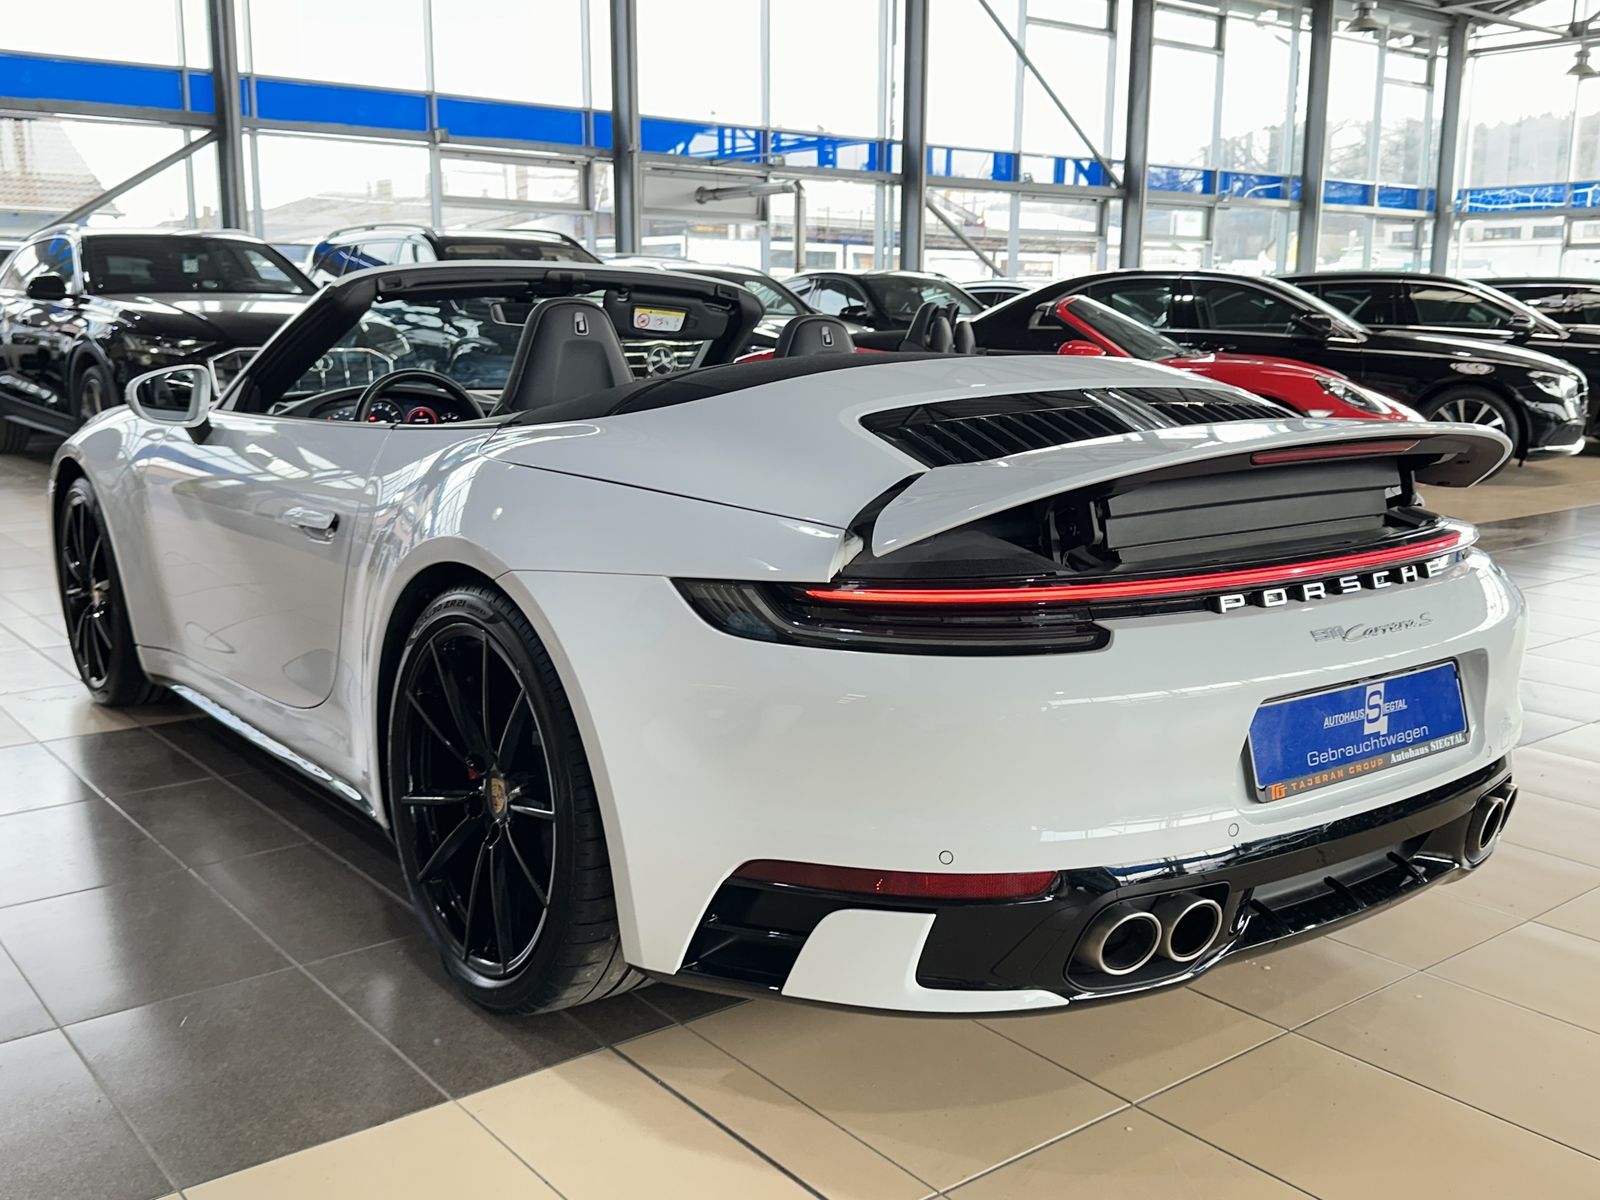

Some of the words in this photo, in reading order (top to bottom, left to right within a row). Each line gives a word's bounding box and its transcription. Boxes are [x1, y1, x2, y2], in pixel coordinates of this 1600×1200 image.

[1219, 557, 1445, 614] PORSCHE
[1341, 622, 1416, 644] Carrera
[1418, 611, 1433, 627] S
[1323, 708, 1366, 729] AUTOHAUS
[1307, 725, 1429, 767] Gebrauchtwagen
[1390, 745, 1430, 764] Autohaus
[1430, 733, 1466, 752] SIEGTAL
[1291, 769, 1345, 791] TAJERAN
[1348, 758, 1384, 775] GROUP
